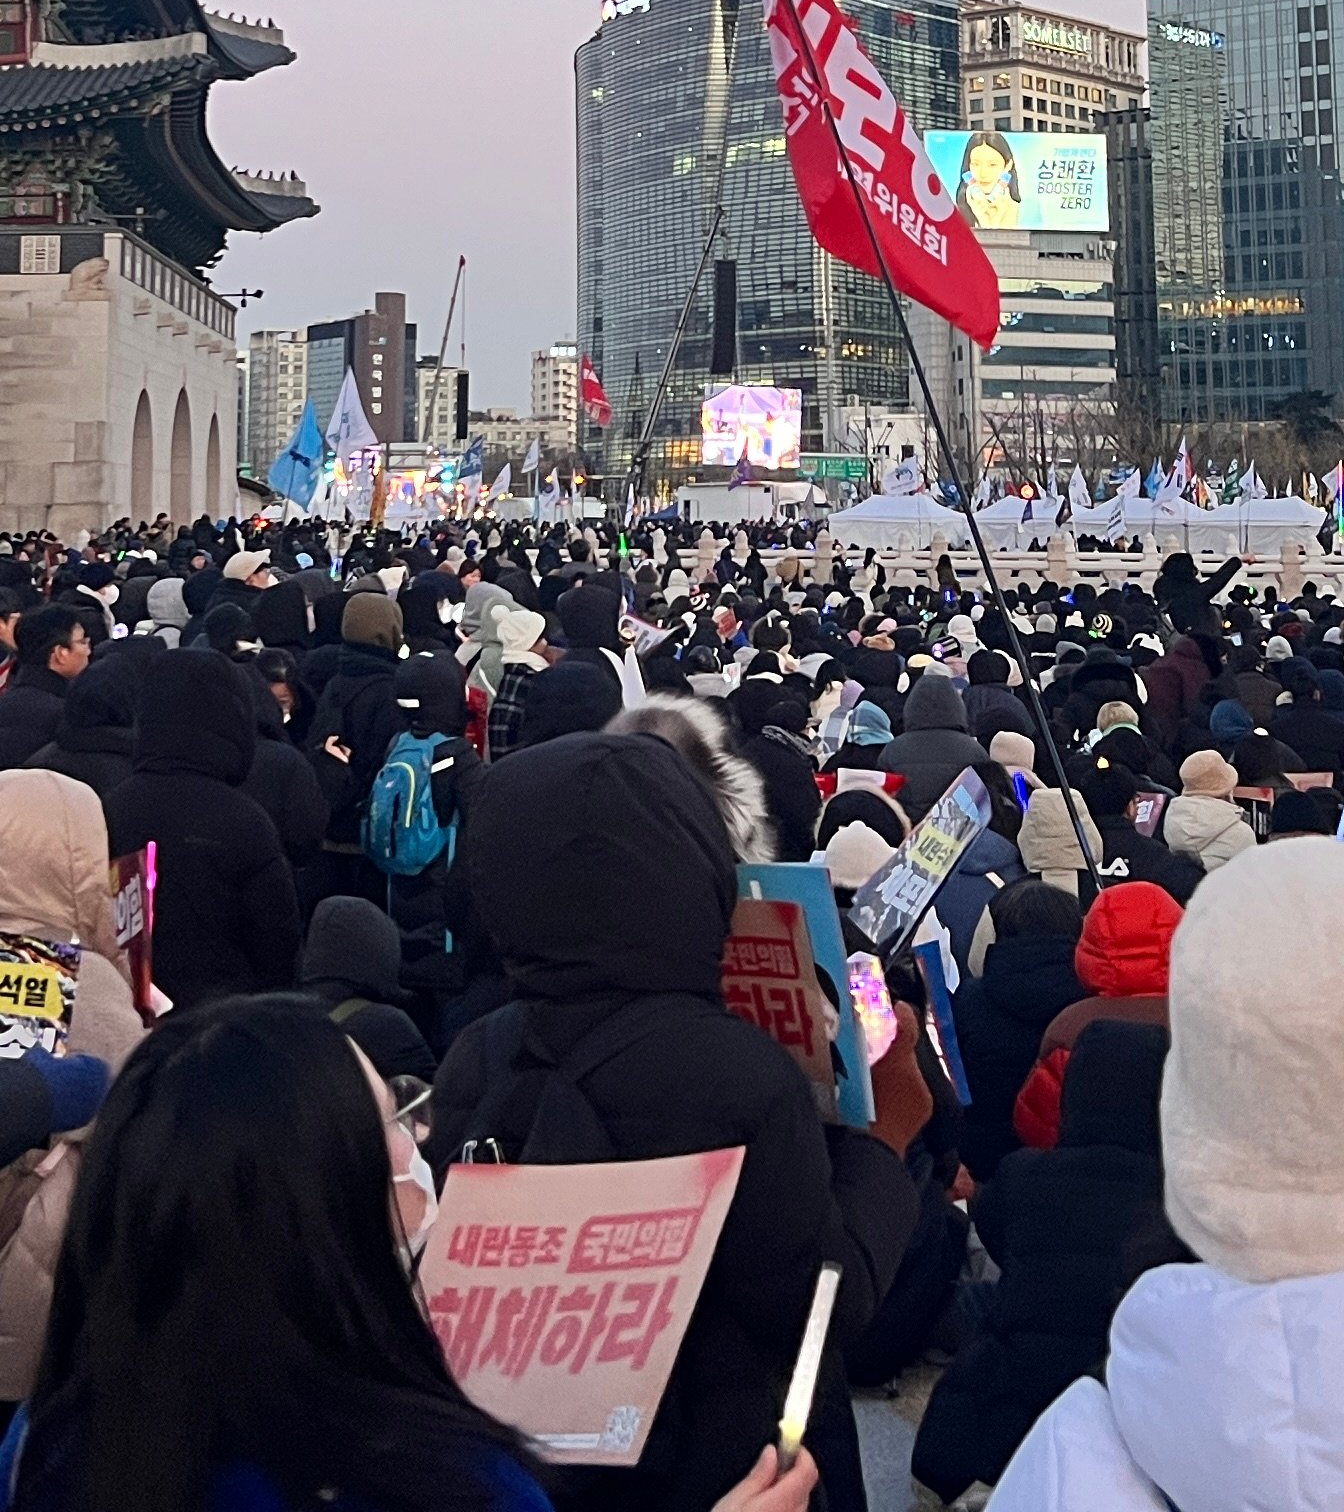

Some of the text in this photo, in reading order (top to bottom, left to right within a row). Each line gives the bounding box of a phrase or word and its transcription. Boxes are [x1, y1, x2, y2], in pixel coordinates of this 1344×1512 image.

[1022, 21, 1091, 52] SOMERSET
[1038, 159, 1096, 180] 상쾌환
[1037, 181, 1093, 196] BOOSTER
[1060, 196, 1092, 210] ZERO
[447, 1218, 689, 1268] 내란동조 국민의힘
[429, 1276, 680, 1381] 해체하라
